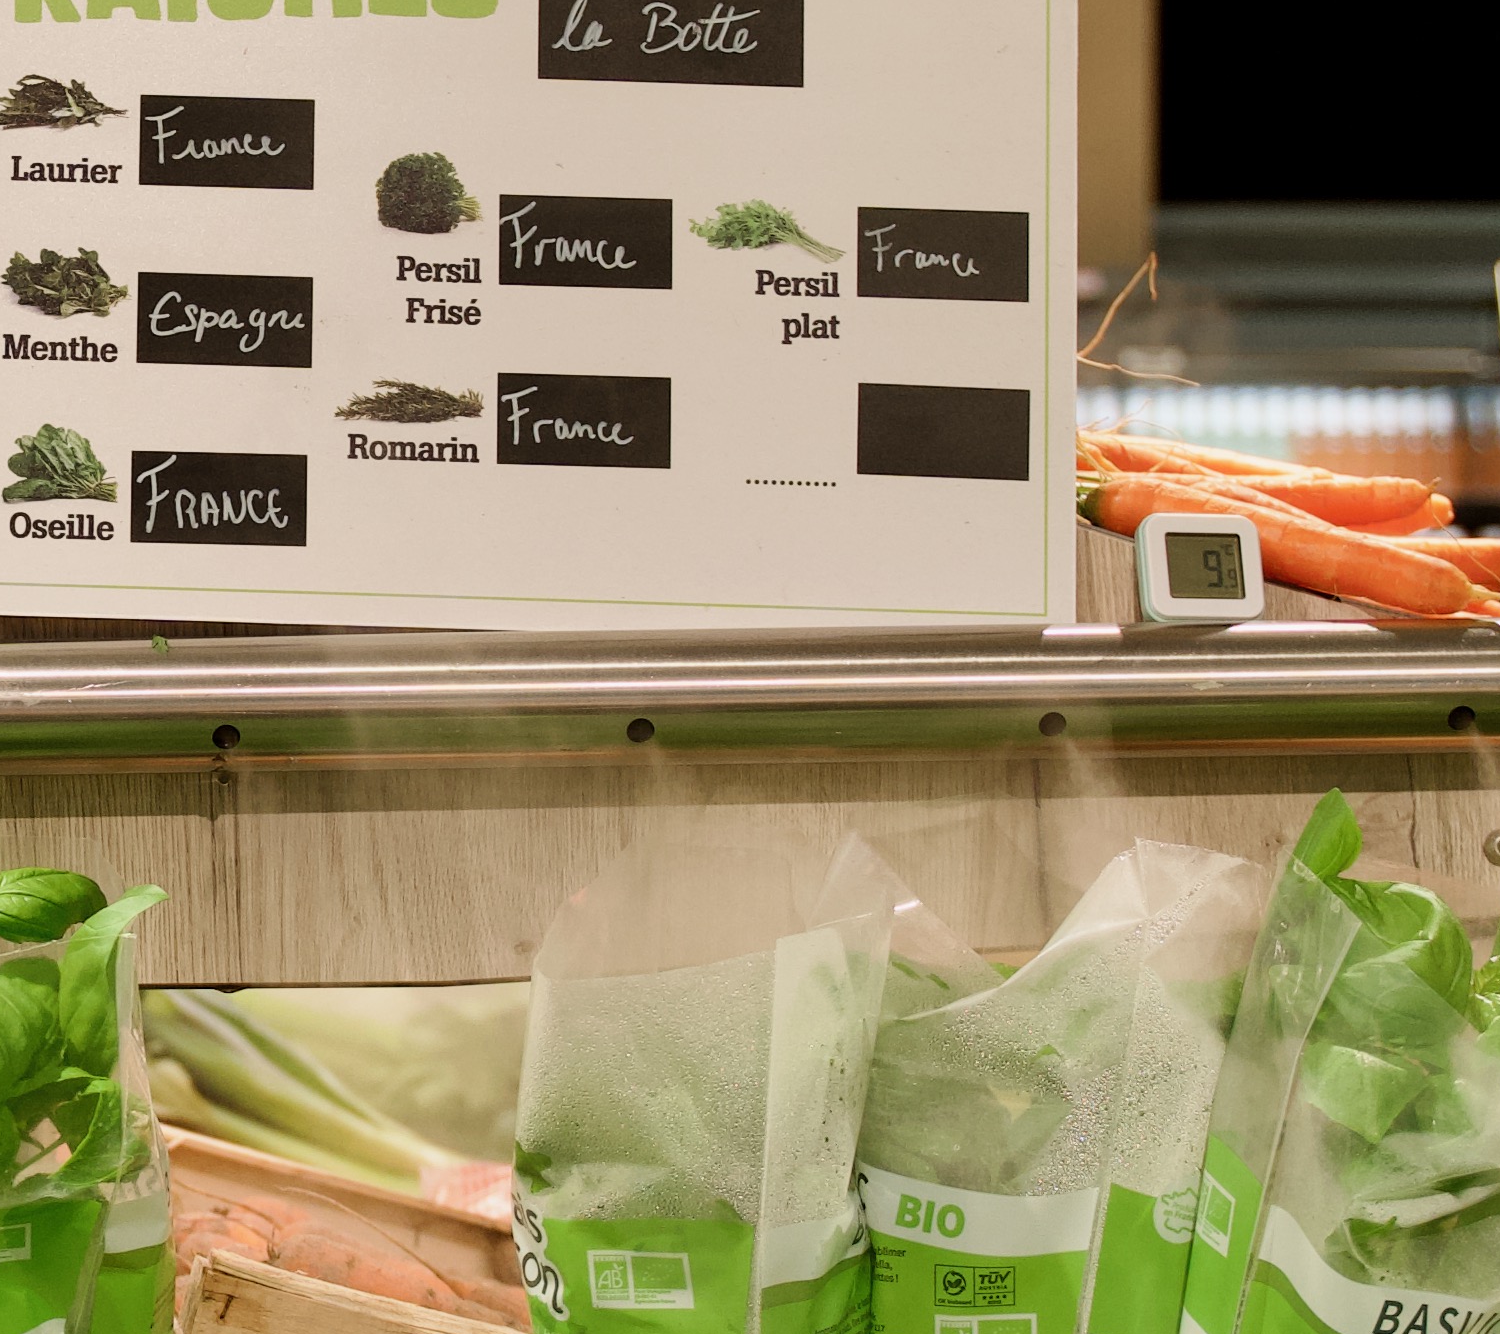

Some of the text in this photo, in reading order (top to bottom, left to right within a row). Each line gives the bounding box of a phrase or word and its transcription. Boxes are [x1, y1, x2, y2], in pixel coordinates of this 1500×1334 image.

[640, 2, 762, 54] Botte
[145, 106, 285, 164] France
[11, 156, 122, 184] Laurier
[500, 202, 637, 269] France
[864, 224, 979, 276] France
[396, 256, 482, 284] Persil
[755, 269, 839, 297] Persil
[406, 298, 482, 325] Frisé
[782, 313, 840, 345] plat
[2, 334, 118, 364] Menthe
[501, 386, 634, 445] France
[347, 434, 480, 463] Romarin
[10, 512, 114, 541] Oseille
[895, 1193, 966, 1238] BIO
